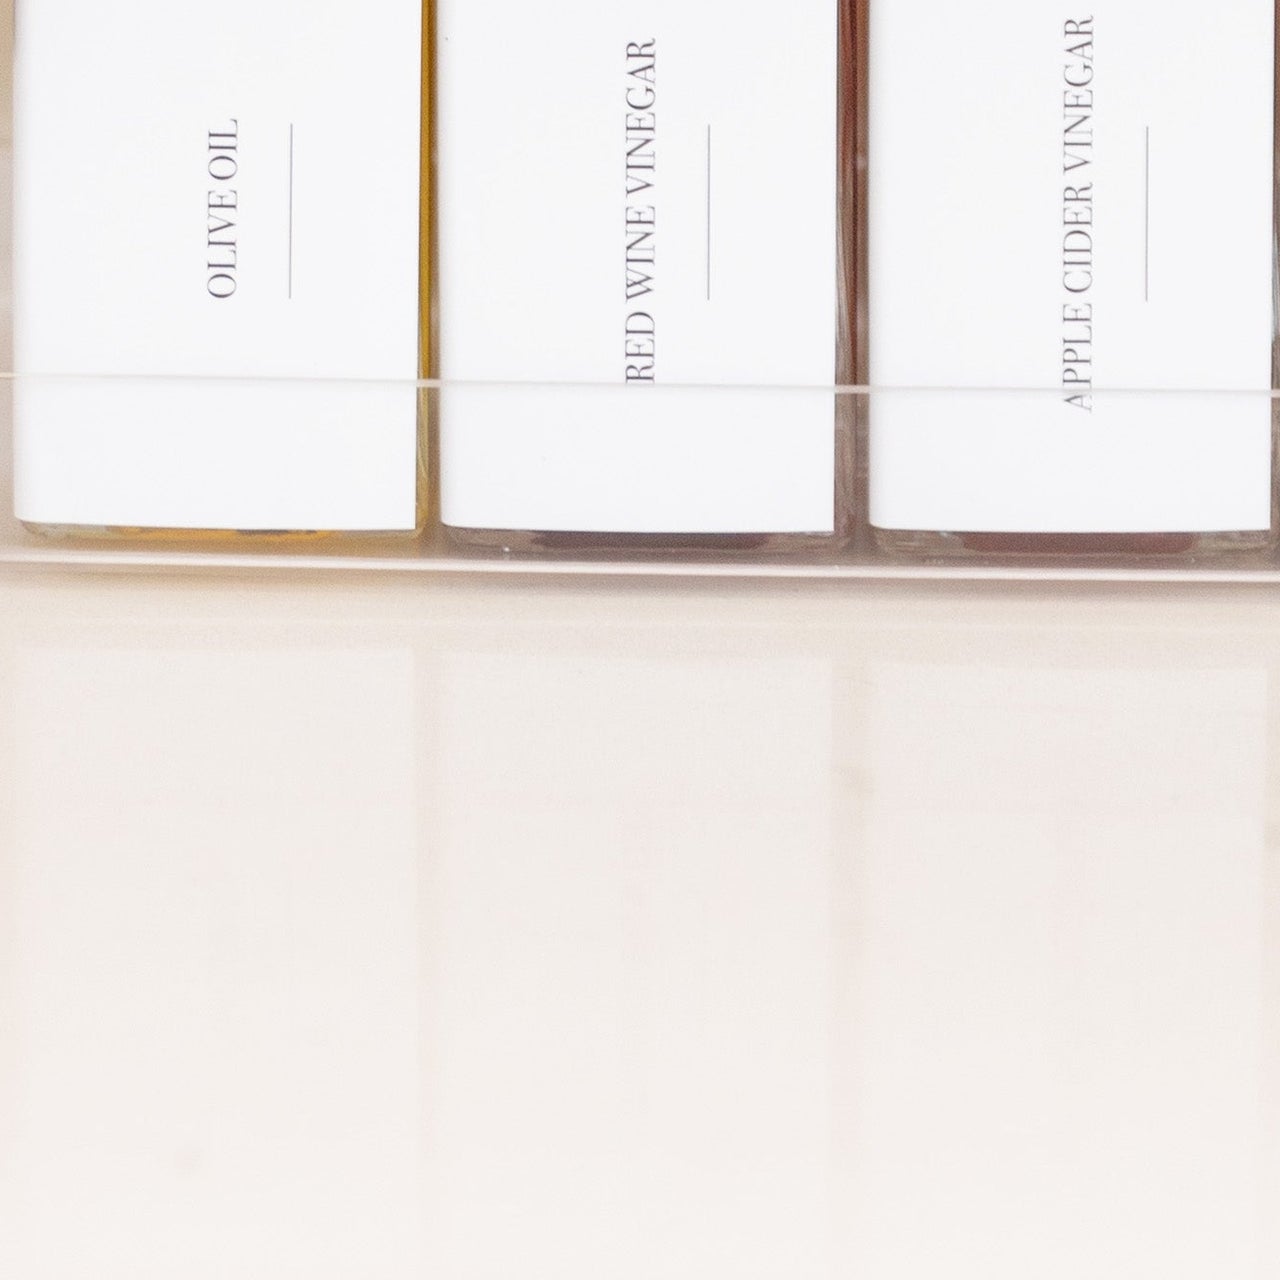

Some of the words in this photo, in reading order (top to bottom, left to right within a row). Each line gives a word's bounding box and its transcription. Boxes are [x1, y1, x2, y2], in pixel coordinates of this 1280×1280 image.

[206, 117, 238, 181] OIL
[624, 37, 657, 198] VINEGAR
[1062, 14, 1094, 175] VINEGAR
[206, 188, 238, 300] OLIVE
[624, 205, 655, 302] WINE
[1062, 181, 1093, 295] CIDER
[624, 310, 656, 384] RED
[1062, 302, 1093, 412] APPLE
